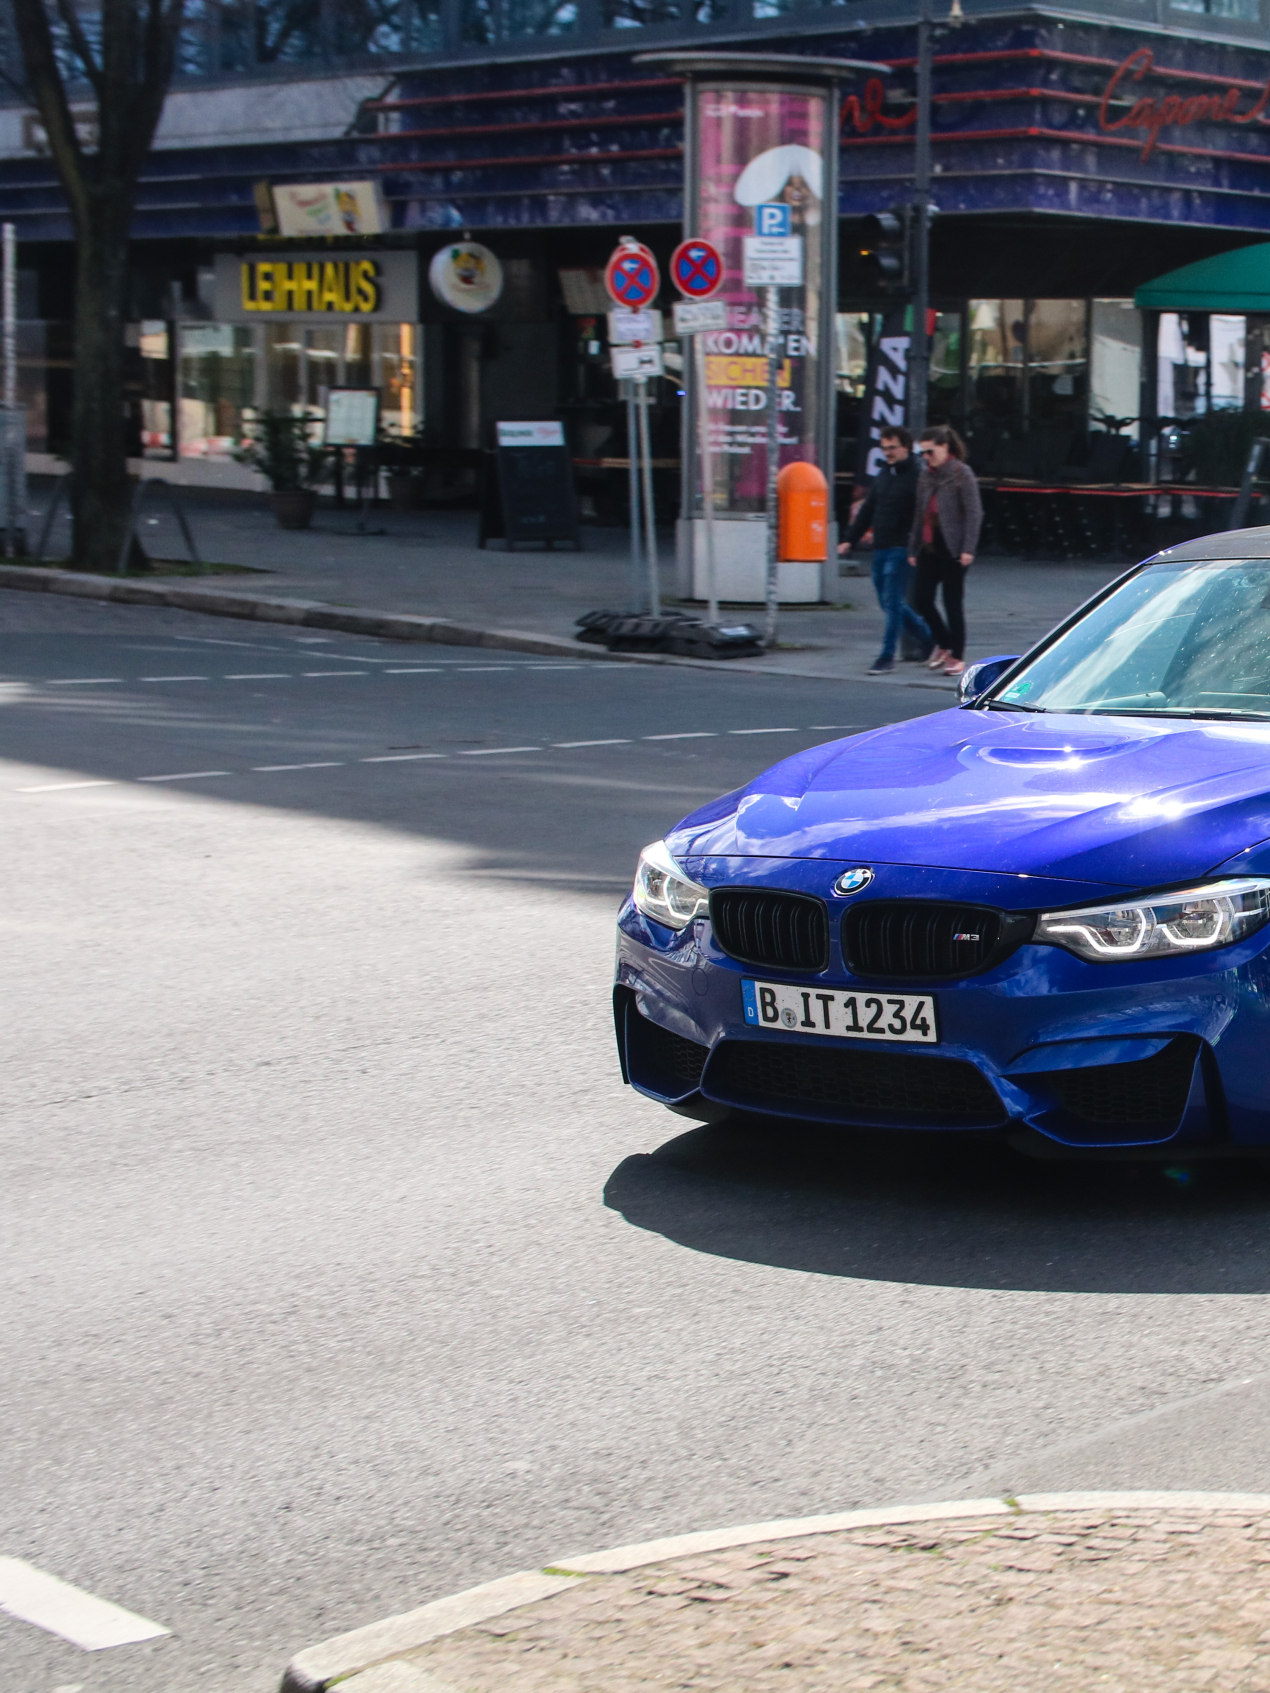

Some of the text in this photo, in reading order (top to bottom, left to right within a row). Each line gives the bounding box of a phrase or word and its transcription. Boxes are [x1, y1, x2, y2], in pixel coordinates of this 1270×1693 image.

[241, 260, 378, 313] LEIHHAUS
[759, 987, 931, 1037] B IT 1234
